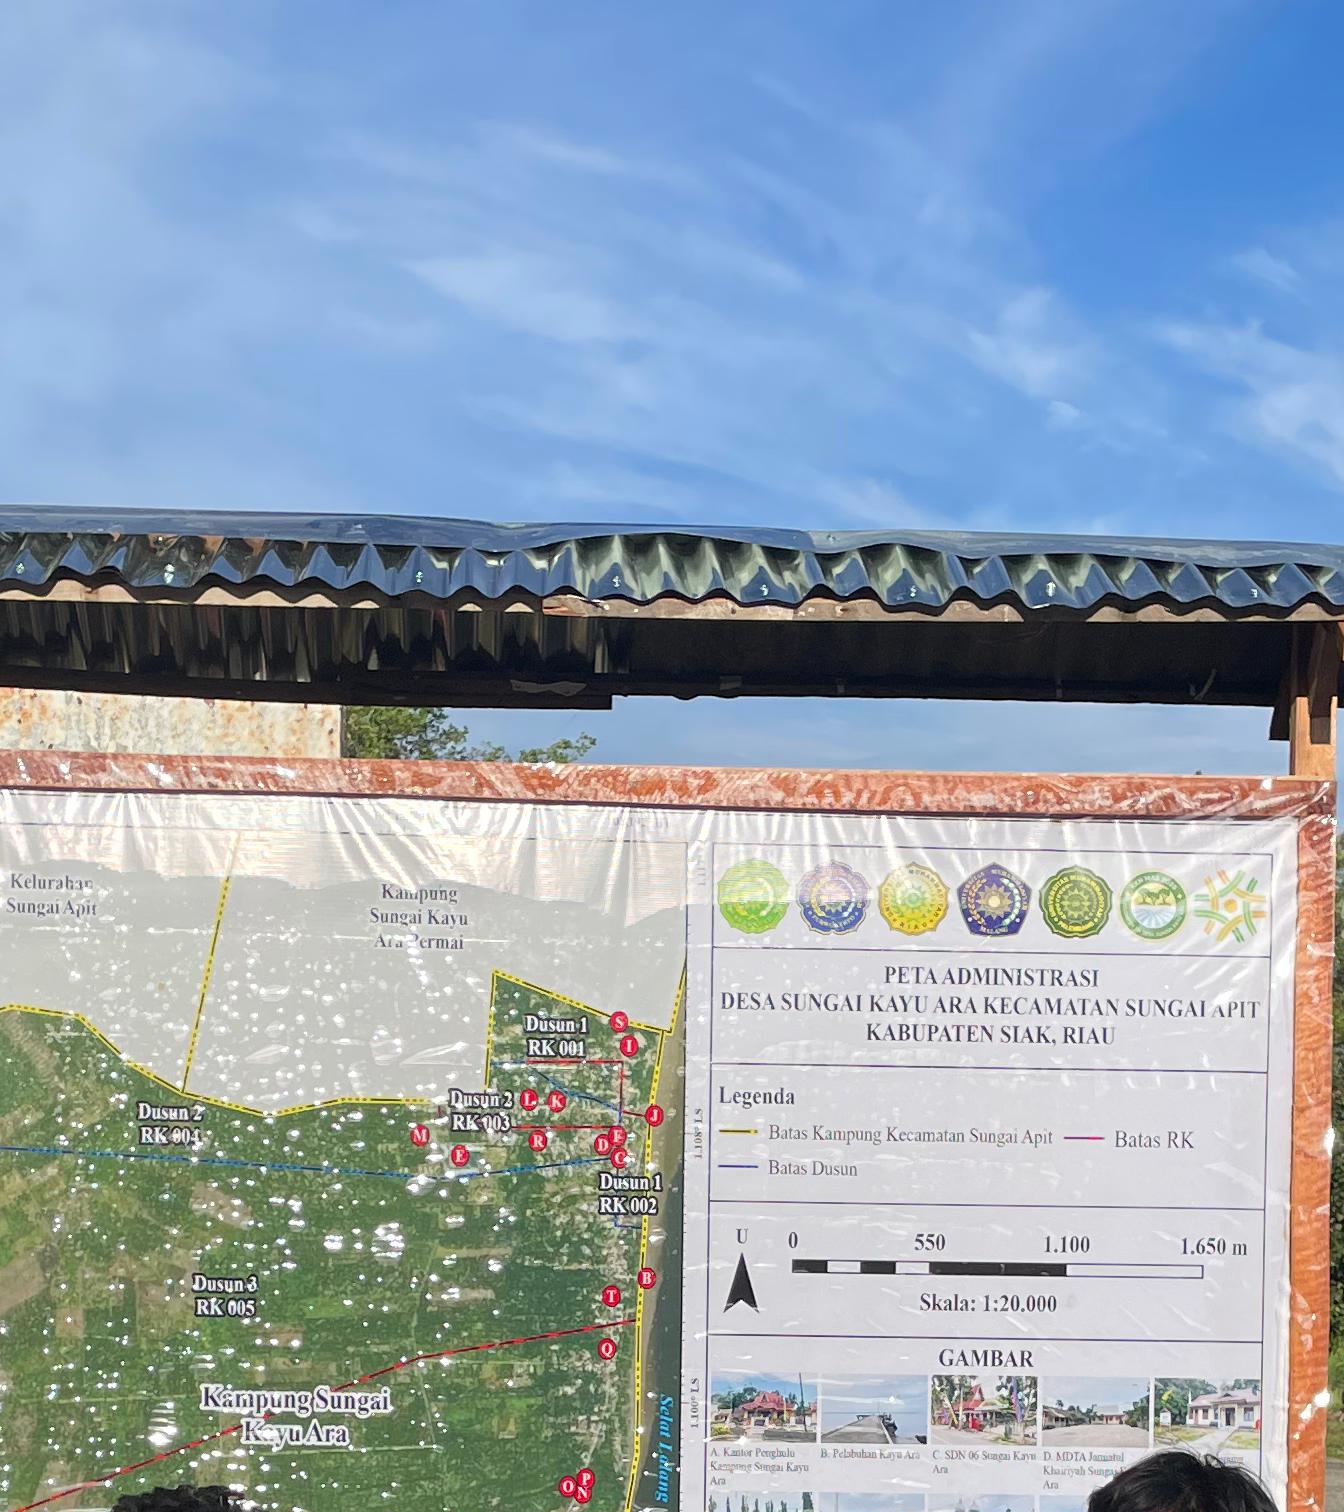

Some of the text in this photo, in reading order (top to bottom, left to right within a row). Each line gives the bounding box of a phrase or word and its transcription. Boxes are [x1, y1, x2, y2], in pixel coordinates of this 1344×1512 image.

[10, 873, 93, 891] Kelurahan
[6, 899, 60, 918] Sungai
[370, 907, 469, 928] Sungai Kayu
[884, 965, 1099, 988] PETA ADMINISTRASI
[720, 991, 1261, 1018] DESA SUNGAI KAYU ARA KECAMATAN SUNGAI APIT
[524, 1016, 588, 1033] Dusun 1
[867, 1023, 1116, 1046] KABUPATEN SIAK, RIAU
[527, 1039, 585, 1057] RK 001
[450, 1091, 513, 1108] Dusun 2
[719, 1086, 795, 1109] Legenda
[137, 1103, 204, 1121] Dusun 2
[693, 1108, 703, 1123] LS
[452, 1114, 511, 1132] RK 003
[140, 1126, 201, 1144] RK 004
[769, 1124, 1194, 1149] Batas Kampung Kecamatan Sungai Apit Batas RK
[769, 1159, 858, 1176] Batas Dusun
[599, 1174, 662, 1192] Dusun 1
[600, 1198, 657, 1215] RK 002
[736, 1228, 749, 1244] U
[788, 1231, 798, 1249] 0
[914, 1233, 946, 1251] 550
[1044, 1235, 1091, 1254] 1.100
[1181, 1237, 1248, 1256] 1.650 m
[193, 1275, 258, 1292] Dusun 3
[195, 1299, 256, 1317] RK 005
[919, 1293, 1057, 1313] Skala: 1:20.000
[938, 1348, 1035, 1368] GAMBAR
[691, 1378, 700, 1393] LS
[203, 1386, 391, 1414] Kampung Sungai
[658, 1393, 675, 1438] Selat
[307, 1422, 349, 1445] Ara
[833, 1449, 877, 1459] Pelabuhan
[904, 1450, 920, 1460] Ara
[945, 1450, 966, 1460] SDN
[968, 1450, 979, 1460] 06
[1056, 1451, 1087, 1462] MDTA
[786, 1463, 809, 1474] Kayu
[932, 1465, 948, 1474] Ara
[710, 1476, 726, 1486] Ara
[1043, 1481, 1059, 1490] Ara
